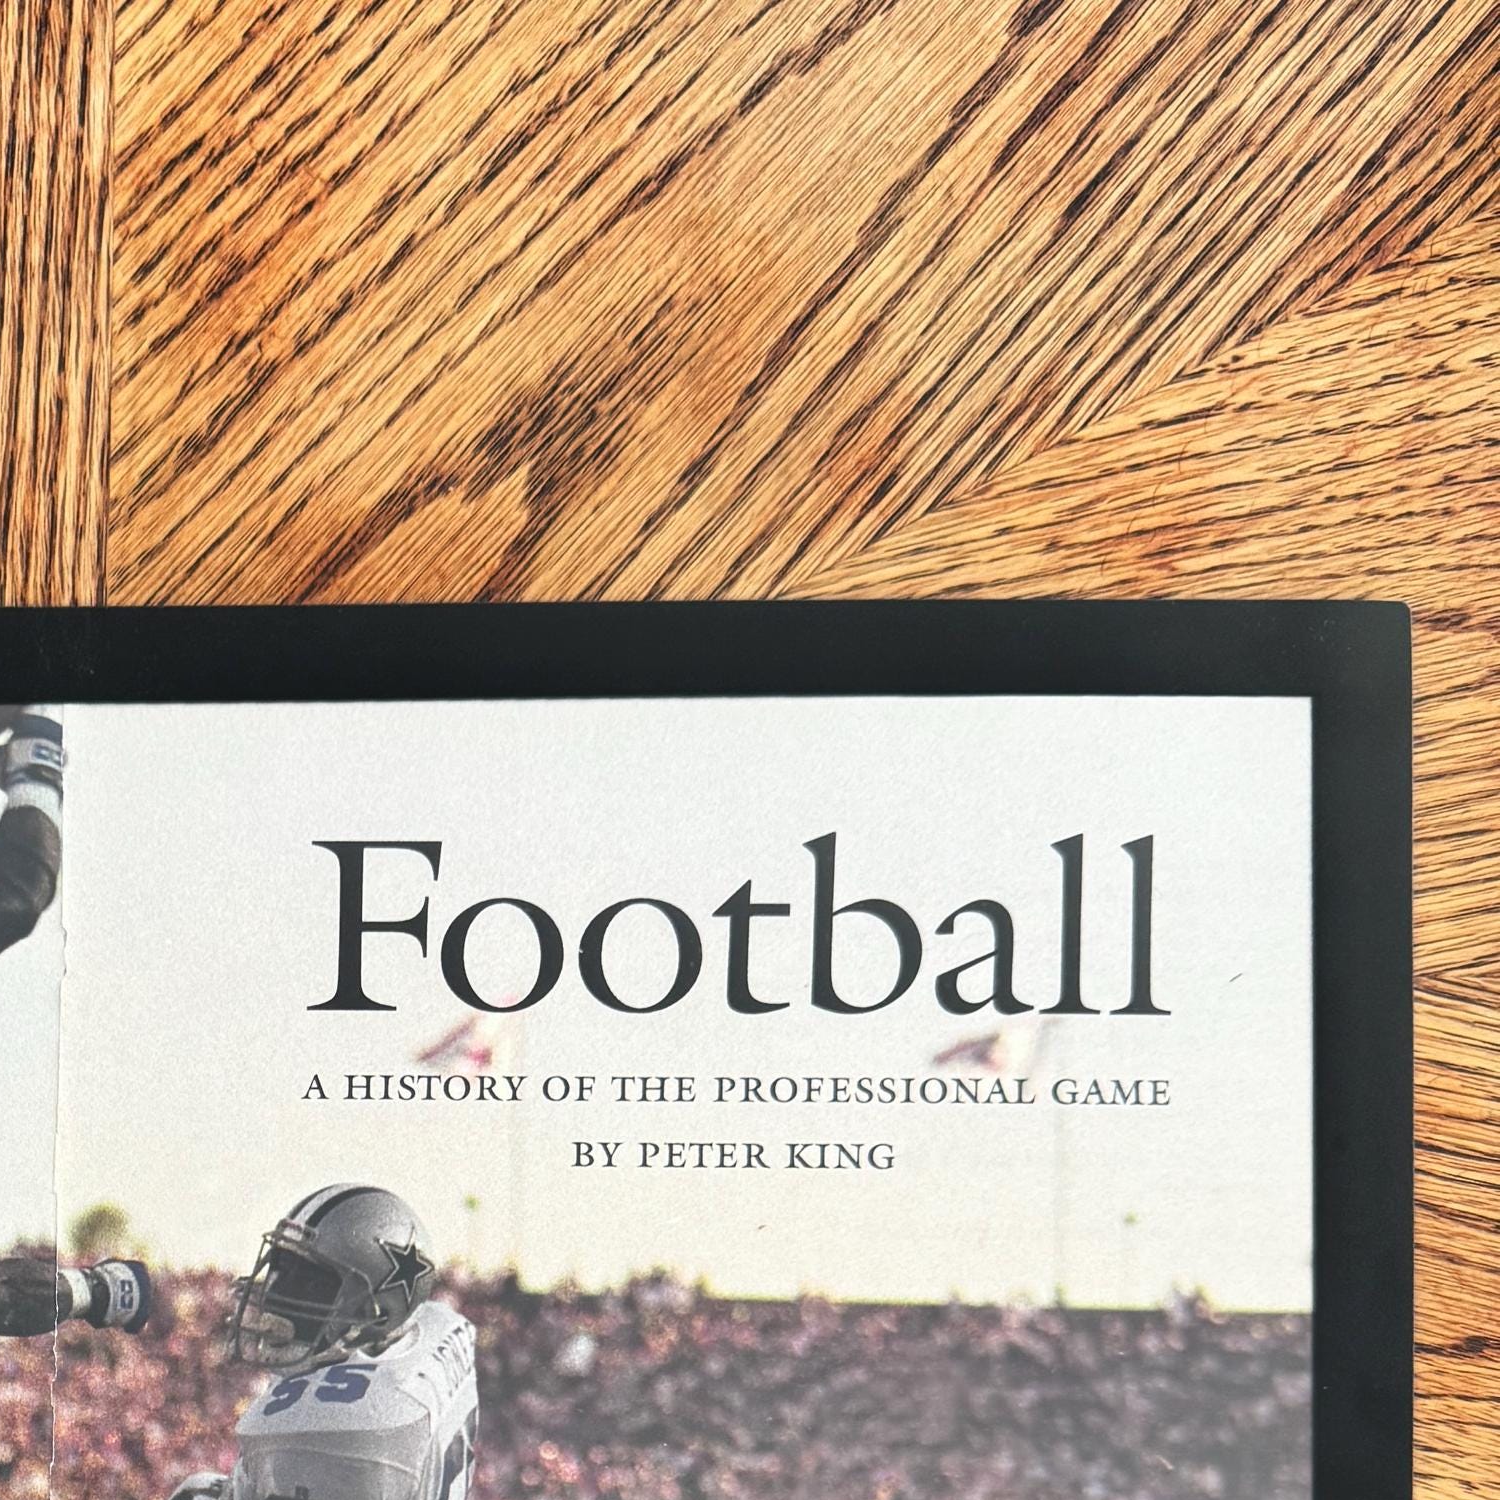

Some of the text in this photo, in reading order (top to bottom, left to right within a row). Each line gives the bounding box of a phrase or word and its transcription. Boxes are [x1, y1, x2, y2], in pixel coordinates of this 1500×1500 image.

[305, 830, 1172, 1016] Football
[301, 1073, 1171, 1106] A HISTORY OF THE PROFESSIONAL GAME
[572, 1140, 896, 1171] BY PETER KING
